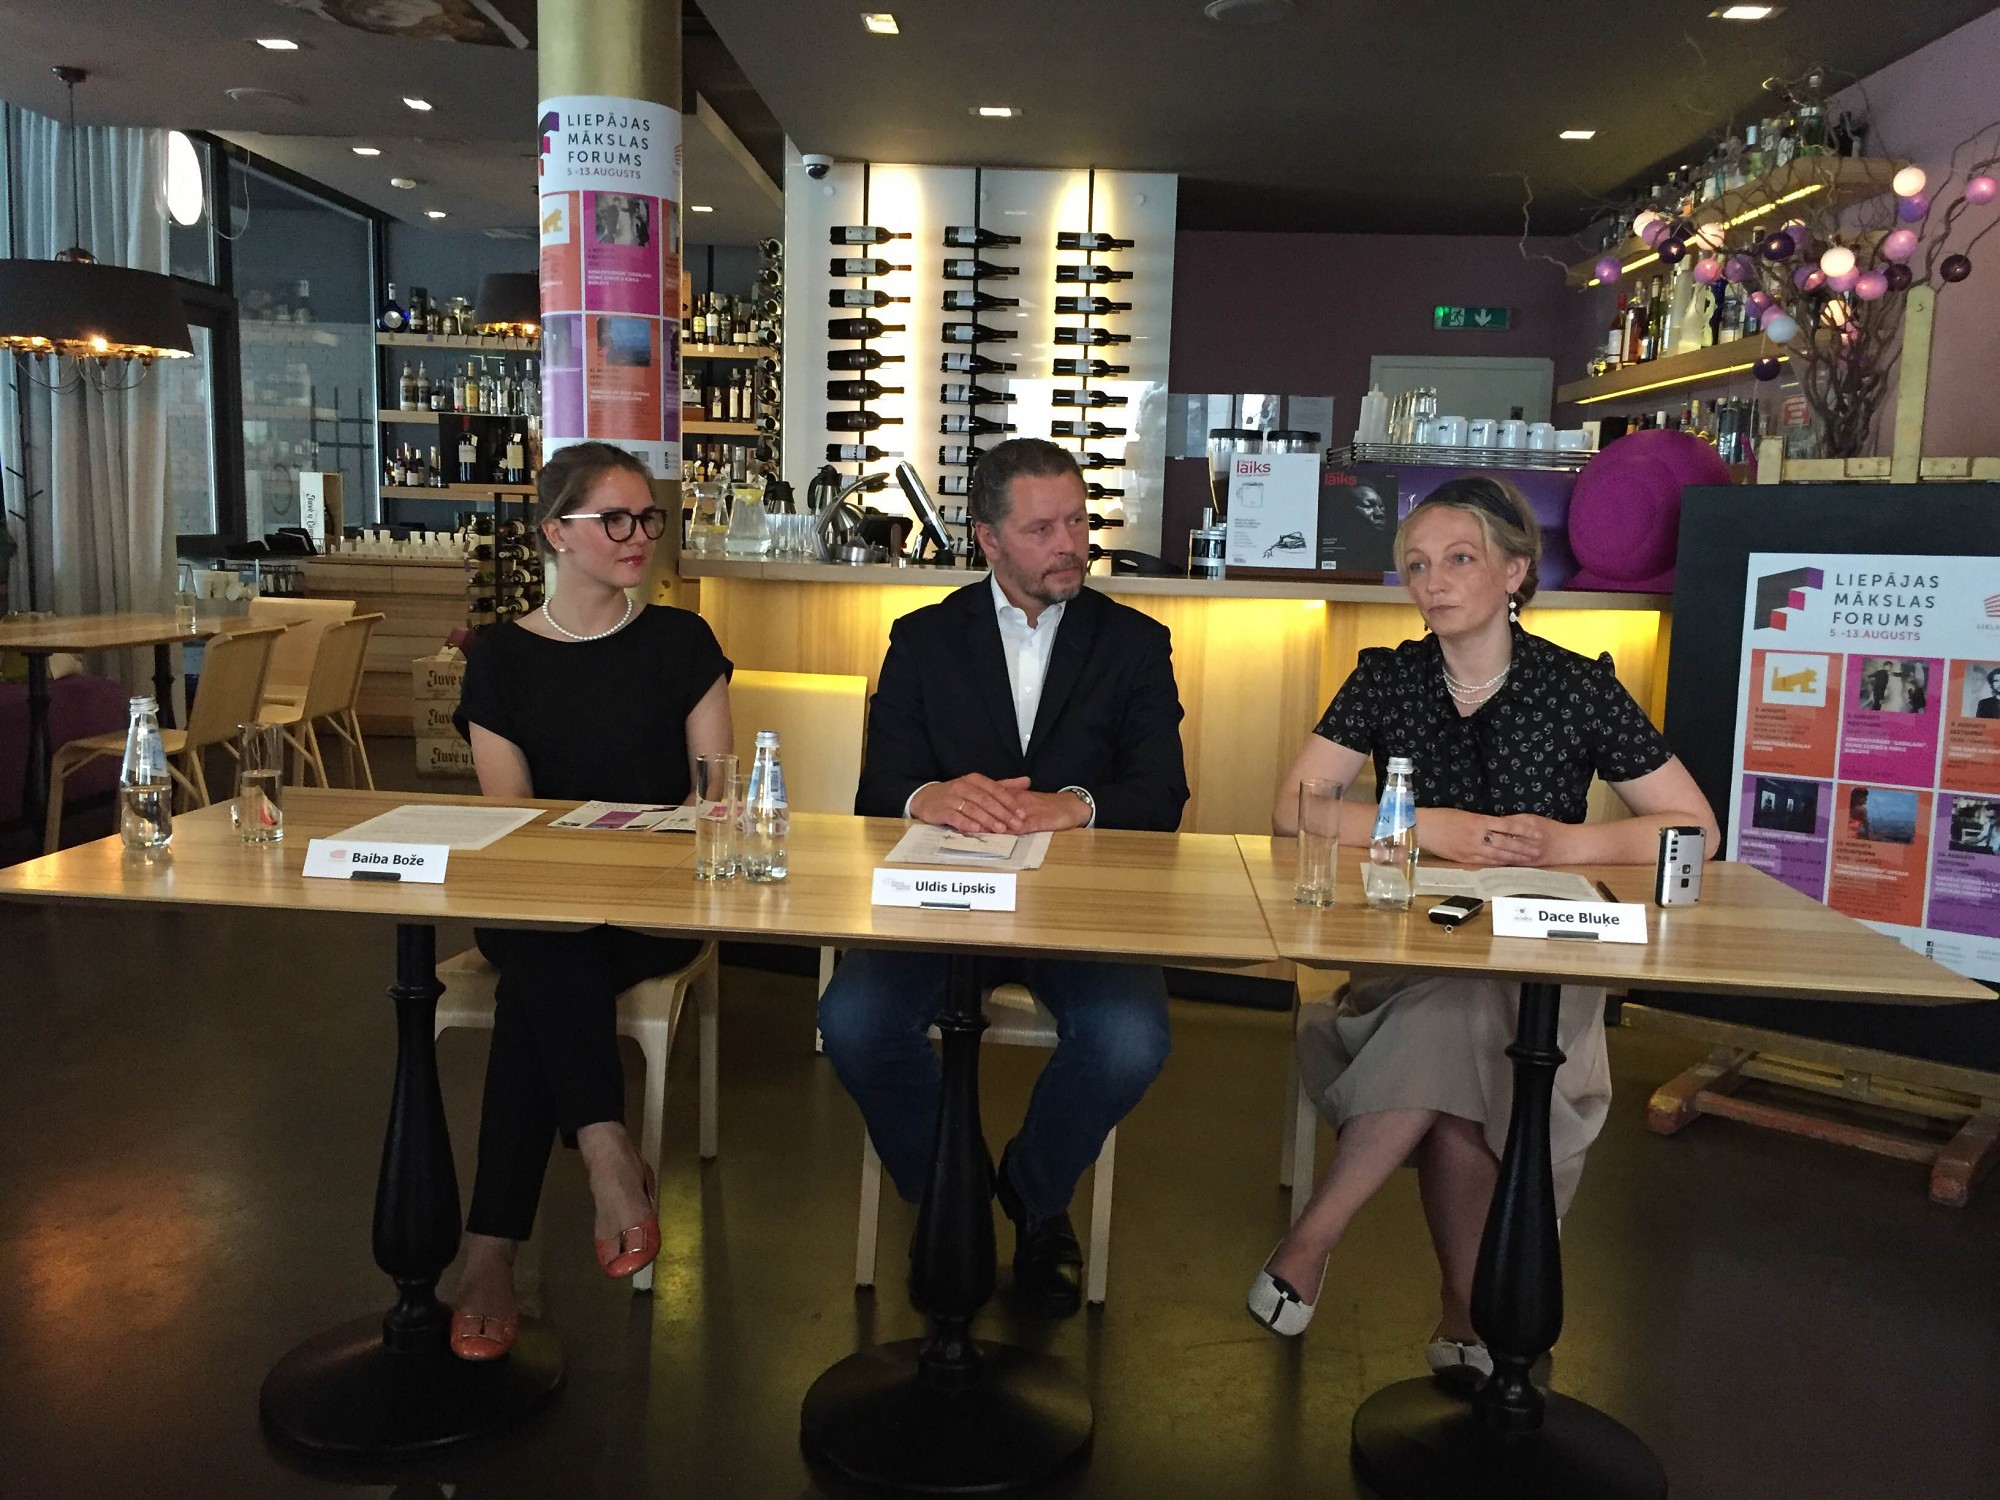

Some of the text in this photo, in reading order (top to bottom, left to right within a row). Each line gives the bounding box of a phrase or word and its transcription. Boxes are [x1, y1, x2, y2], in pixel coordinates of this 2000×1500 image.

[567, 112, 650, 132] LIEPĀJAS
[567, 130, 649, 150] MĀKSLAS
[568, 151, 642, 167] FORUMS
[593, 168, 641, 179] AUGUSTS
[1236, 460, 1271, 474] laiks
[1325, 471, 1358, 486] laiks
[1835, 572, 1939, 588] LIEPĀJAS
[1834, 590, 1936, 609] MĀKSLAS
[1832, 611, 1923, 628] FORUMS
[1862, 630, 1921, 641] AUGUSTS
[427, 708, 452, 727] Juv
[351, 852, 425, 866] Baiba Bože
[915, 881, 948, 893] Uldis
[951, 882, 996, 896] Lipskis
[1538, 910, 1575, 923] Dace
